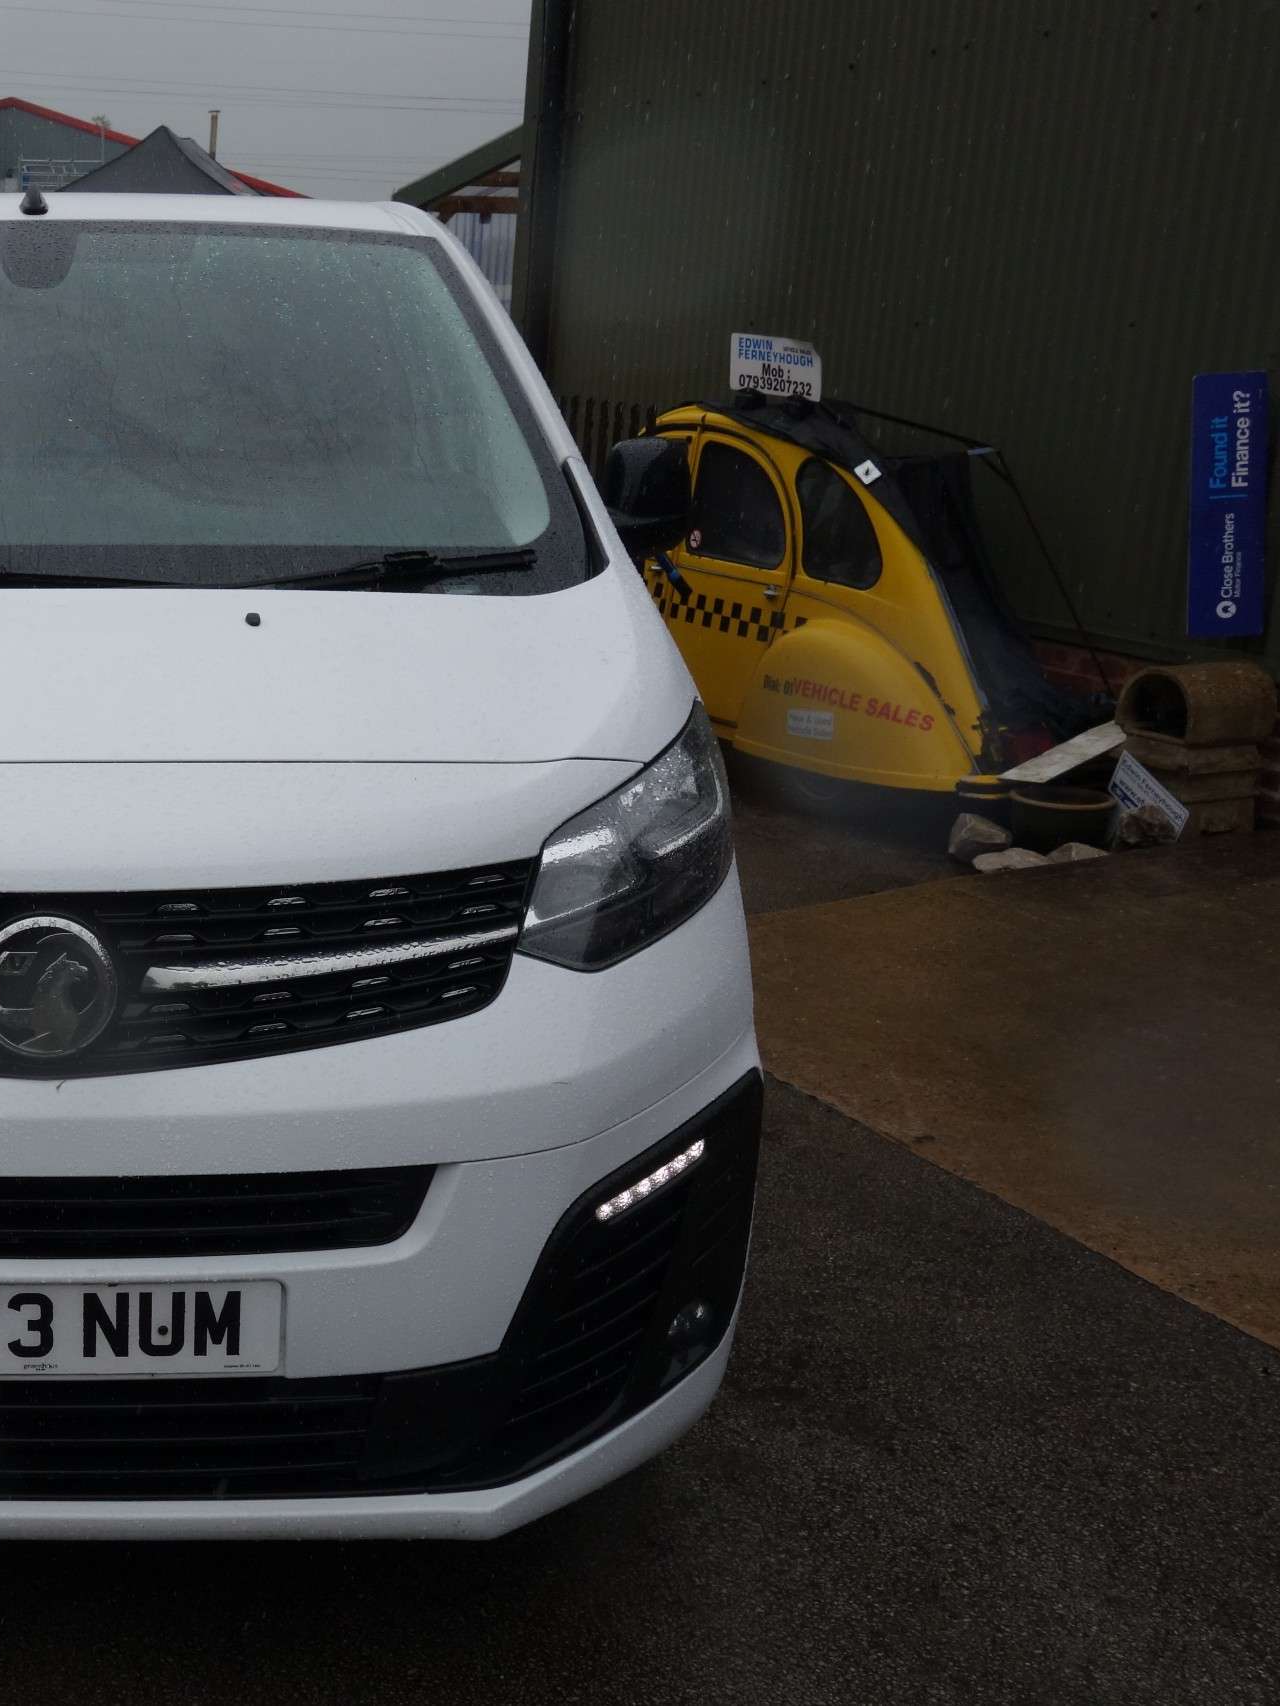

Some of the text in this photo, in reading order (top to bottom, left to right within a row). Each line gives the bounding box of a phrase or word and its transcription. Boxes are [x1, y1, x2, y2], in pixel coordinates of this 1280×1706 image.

[738, 337, 773, 351] EDWIN
[738, 348, 814, 368] FERNEYHOUGH
[738, 374, 812, 397] 07939207232
[1209, 416, 1228, 489] Found it
[1231, 390, 1251, 488] Finance it?
[1220, 513, 1235, 598] Close Brothers
[794, 678, 861, 712] VEHICLE
[866, 697, 936, 732] SALES
[82, 1290, 241, 1358] NUM
